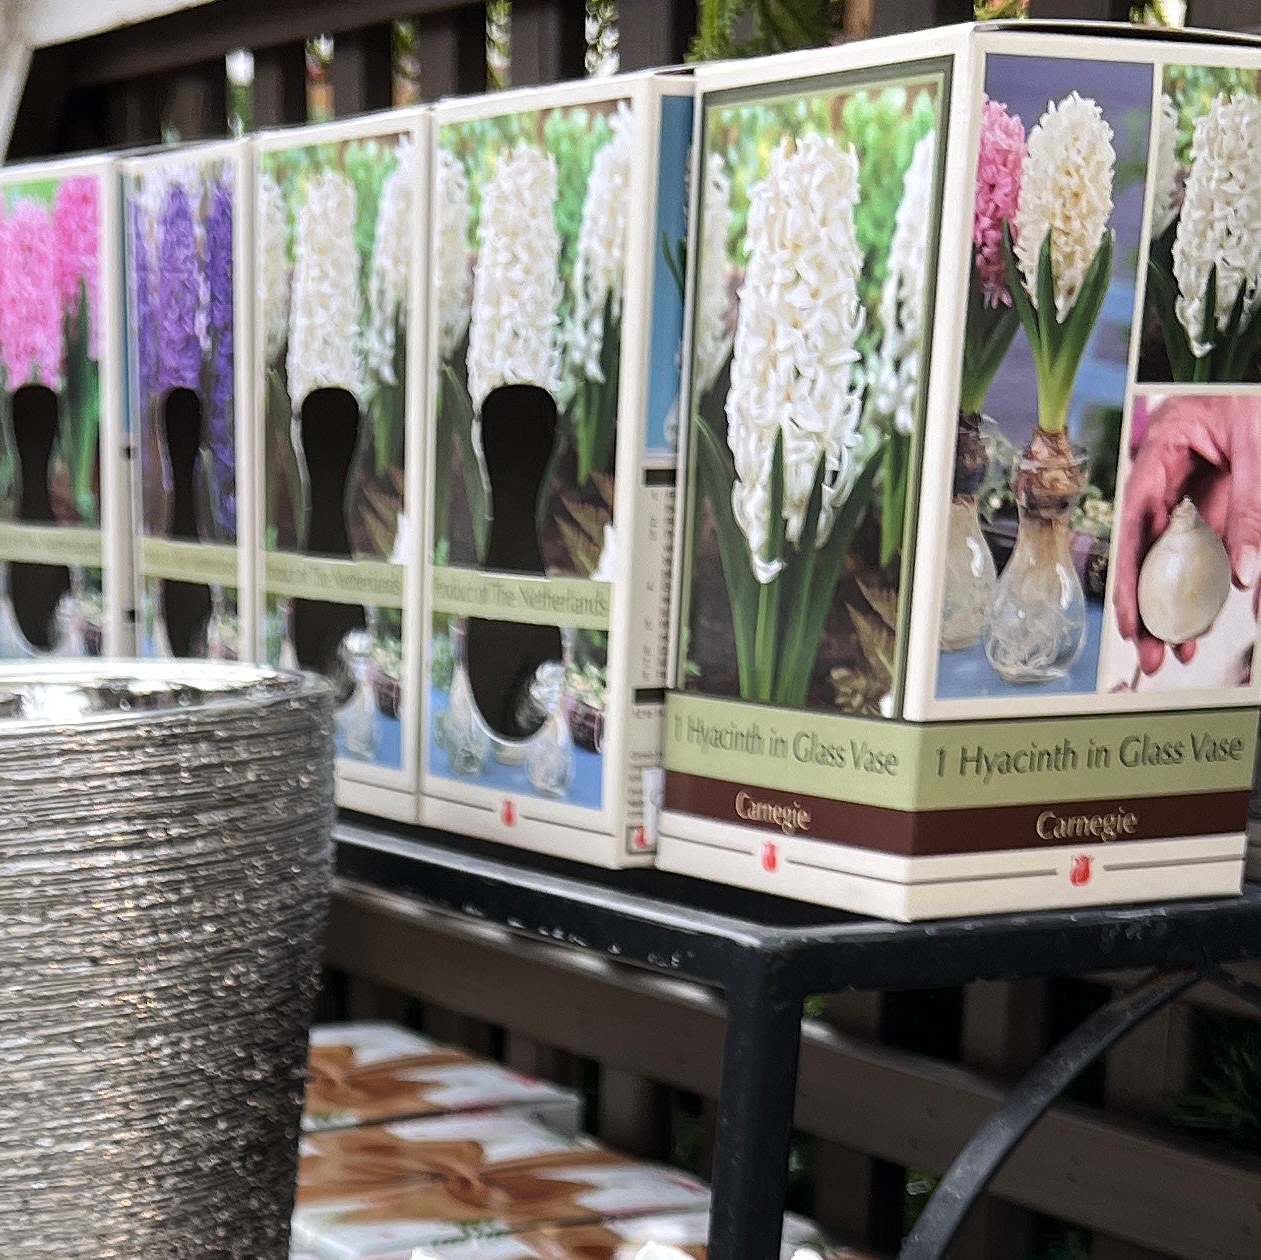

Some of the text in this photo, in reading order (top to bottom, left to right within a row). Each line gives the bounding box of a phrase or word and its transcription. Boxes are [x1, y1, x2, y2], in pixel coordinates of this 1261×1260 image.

[674, 713, 682, 743] 1
[687, 715, 765, 756] Hyacinth
[769, 727, 789, 759] in
[793, 729, 846, 768] Glass
[850, 738, 899, 776] Vase
[935, 731, 1244, 784] 1 Hyacinth in Glass Vase
[735, 790, 812, 834] Carnegie
[1036, 806, 1139, 843] Carnegie
